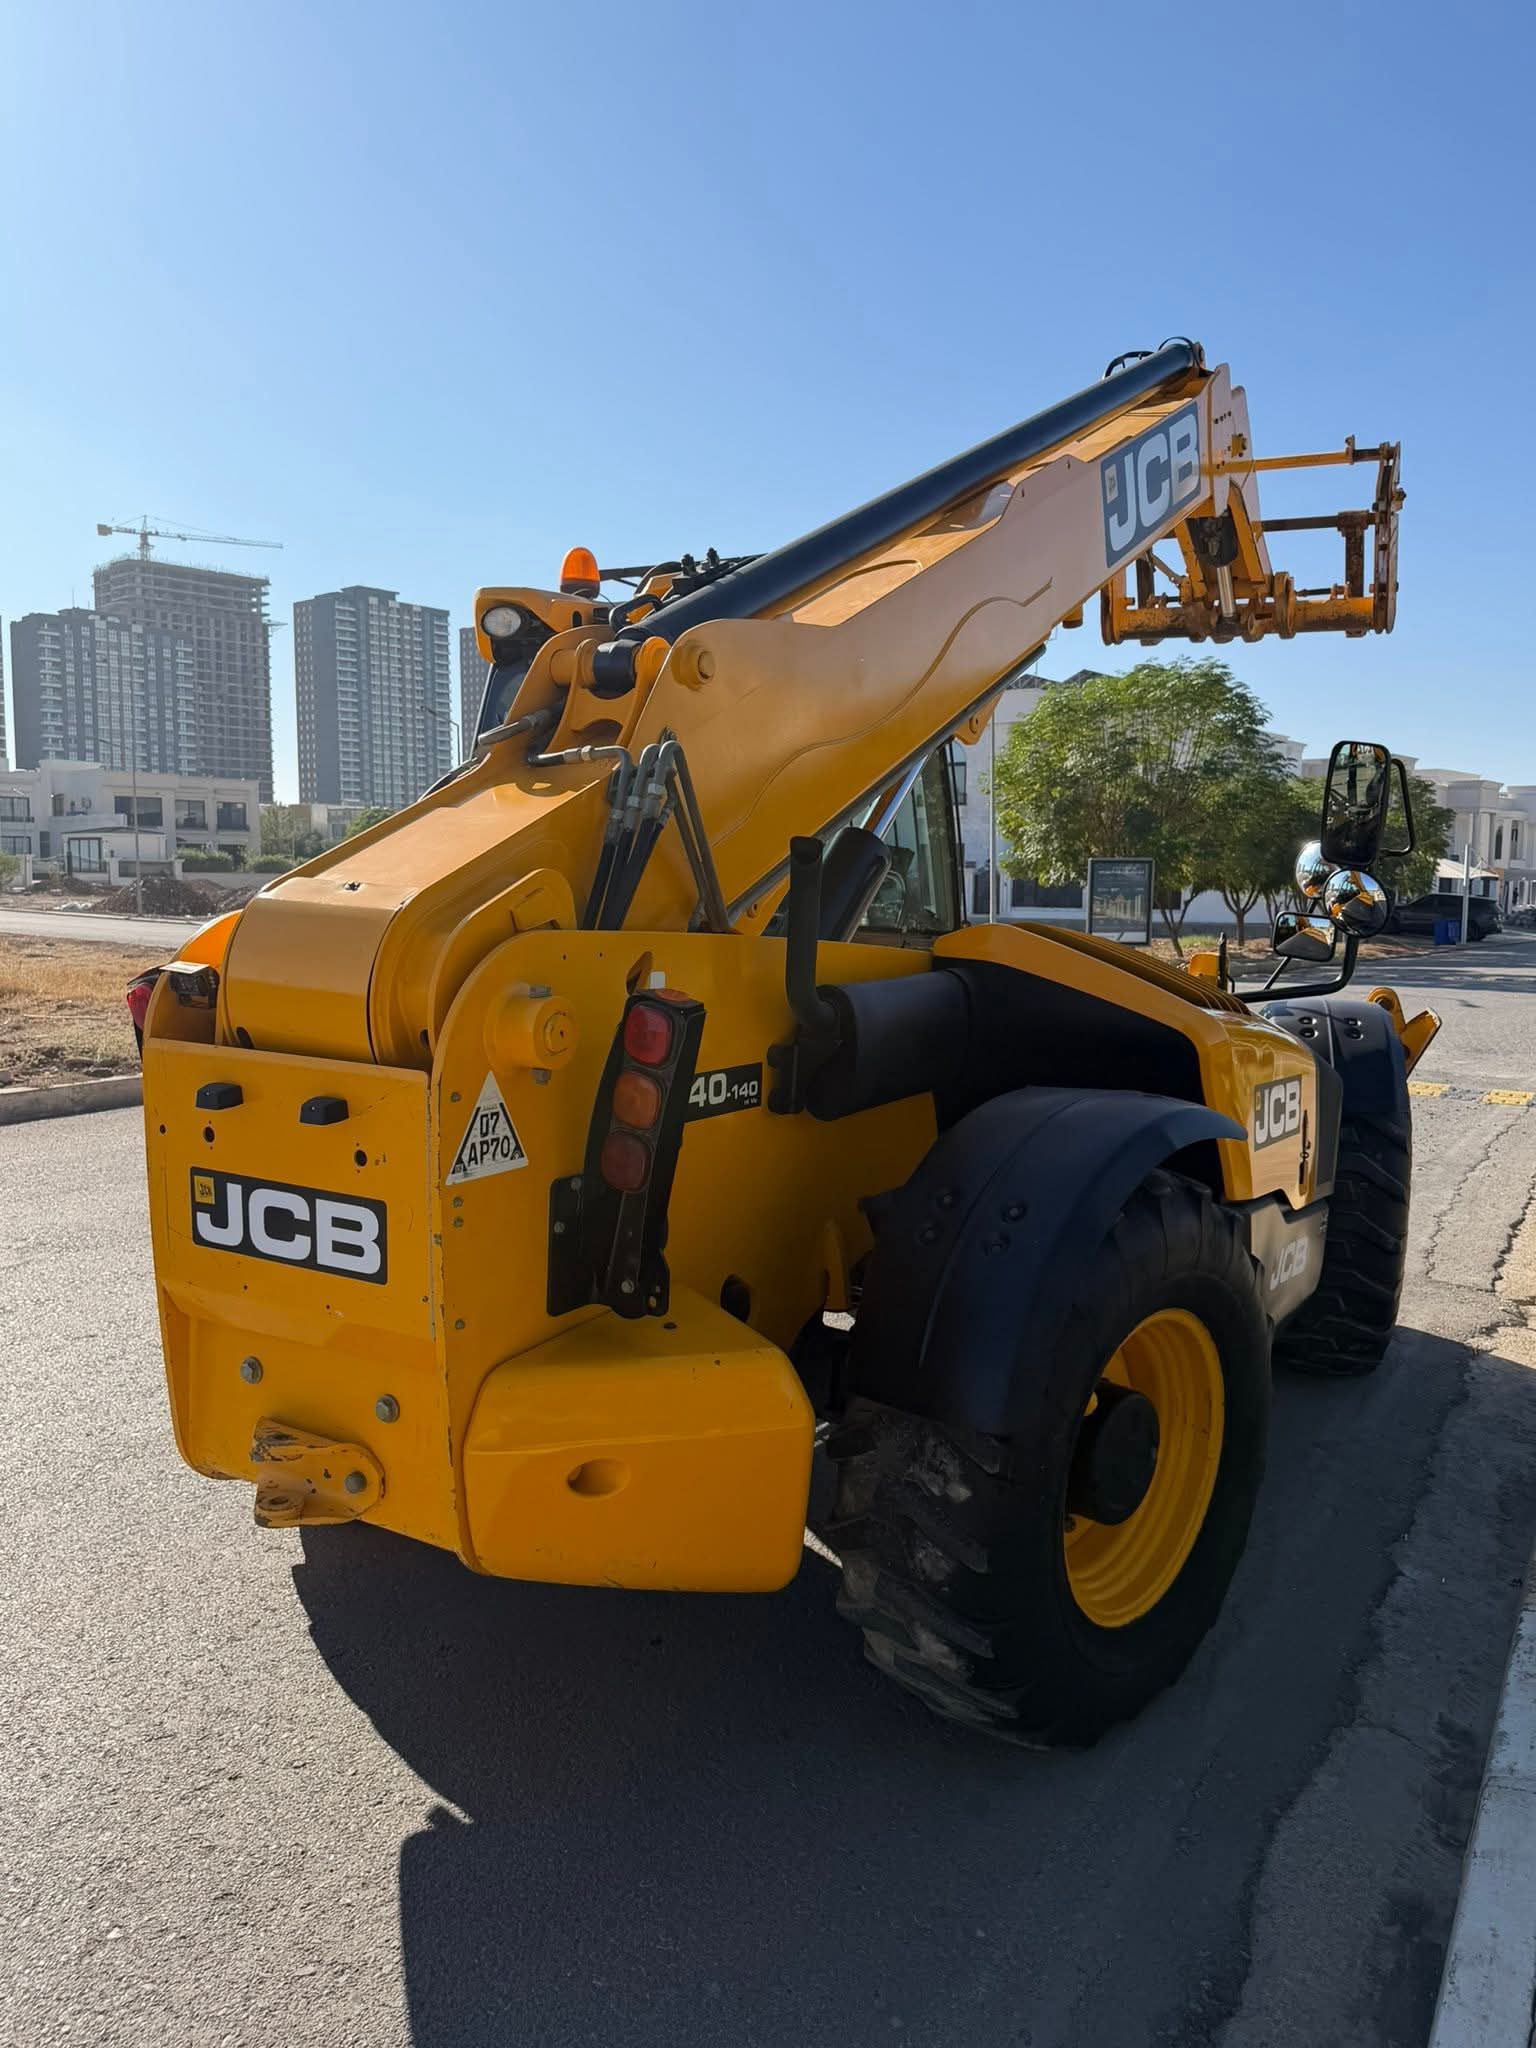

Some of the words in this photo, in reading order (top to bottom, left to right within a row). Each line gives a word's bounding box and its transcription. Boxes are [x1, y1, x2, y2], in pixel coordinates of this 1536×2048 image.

[1109, 413, 1200, 551] JCB
[687, 1072, 759, 1107] 40-140
[1255, 1079, 1300, 1145] JCB
[480, 1111, 500, 1138] 07
[467, 1136, 511, 1168] AP70
[196, 1182, 382, 1275] JCB
[1270, 1238, 1308, 1290] JCB
